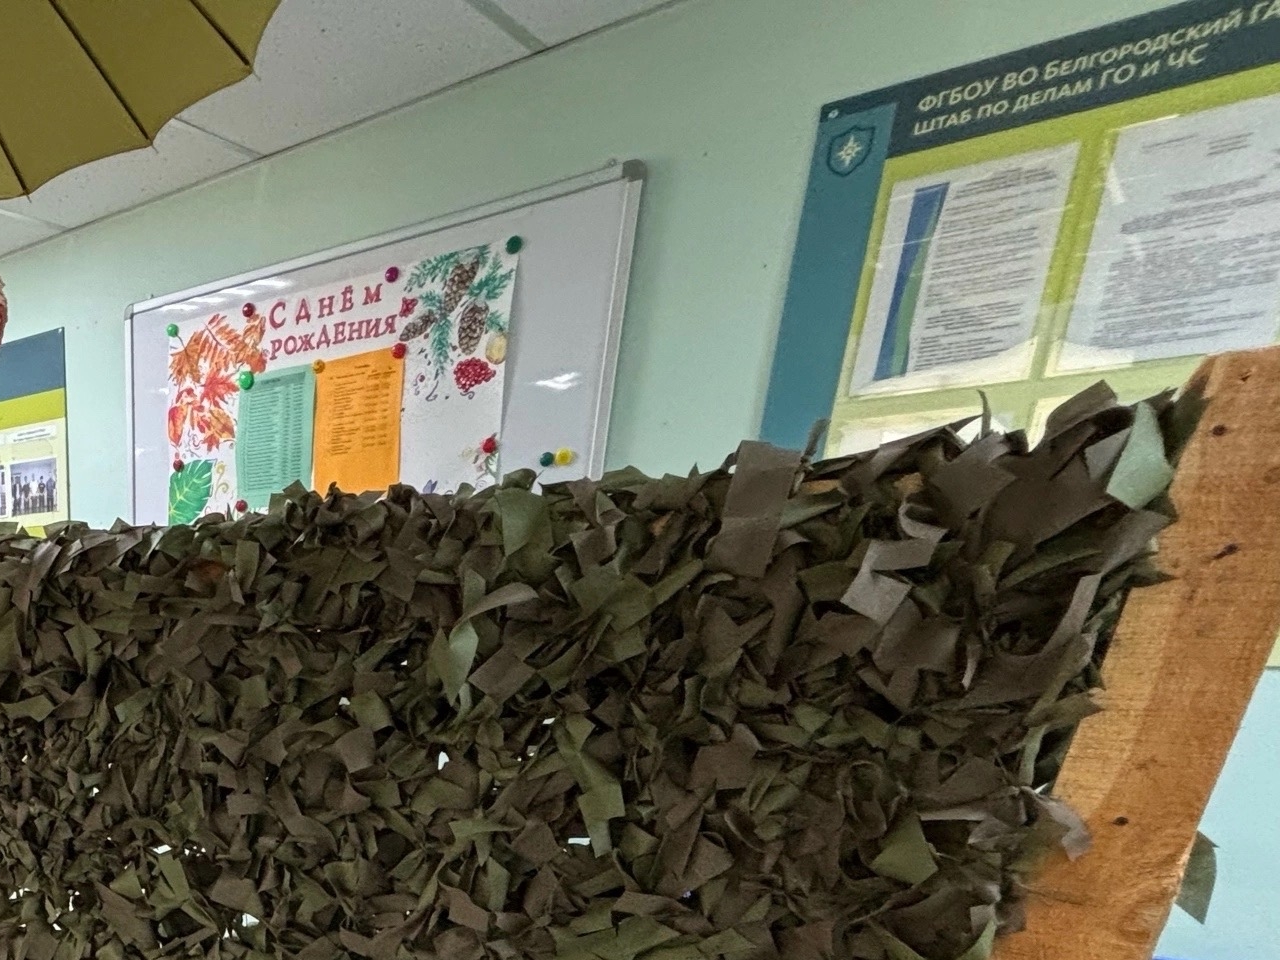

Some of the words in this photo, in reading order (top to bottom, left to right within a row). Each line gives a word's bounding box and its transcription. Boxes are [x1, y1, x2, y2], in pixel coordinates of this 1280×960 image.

[913, 107, 972, 136] ШТАБ
[976, 100, 1009, 119] ПО
[1011, 77, 1092, 114] ДЕЛАМ
[1098, 63, 1136, 90] ГО
[1168, 42, 1209, 68] ЧС
[918, 76, 999, 112] ФГБОУ
[1002, 65, 1040, 92] ВО
[1043, 8, 1243, 81] БЕЛГОРОДСКИЙ
[1248, 0, 1280, 25] ГА
[269, 301, 286, 330] С
[295, 283, 383, 325] ДНЁМ
[269, 314, 398, 361] РОЖДЕНИЯ
